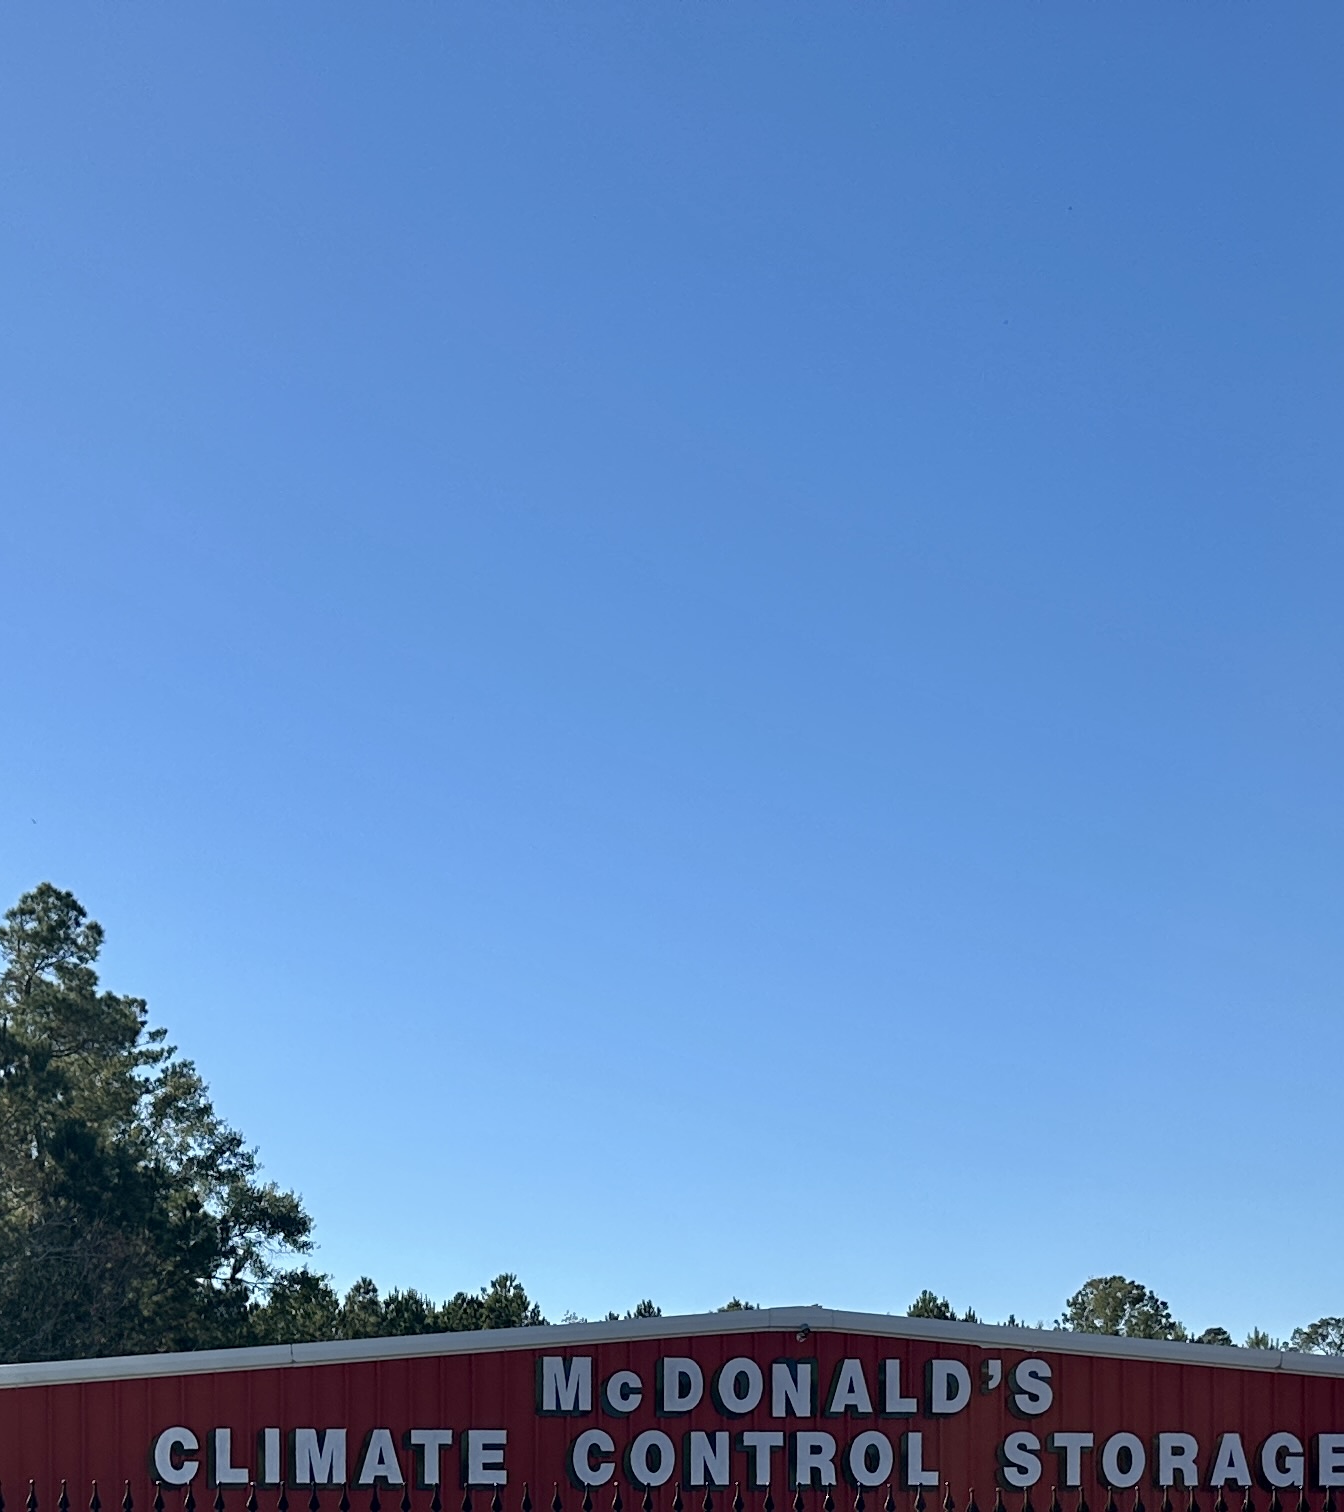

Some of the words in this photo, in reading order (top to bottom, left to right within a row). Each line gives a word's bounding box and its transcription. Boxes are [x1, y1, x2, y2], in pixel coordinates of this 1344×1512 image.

[541, 1355, 1054, 1417] McDONALD'S
[154, 1426, 508, 1485] CLIMATE
[571, 1428, 940, 1487] CONTROL
